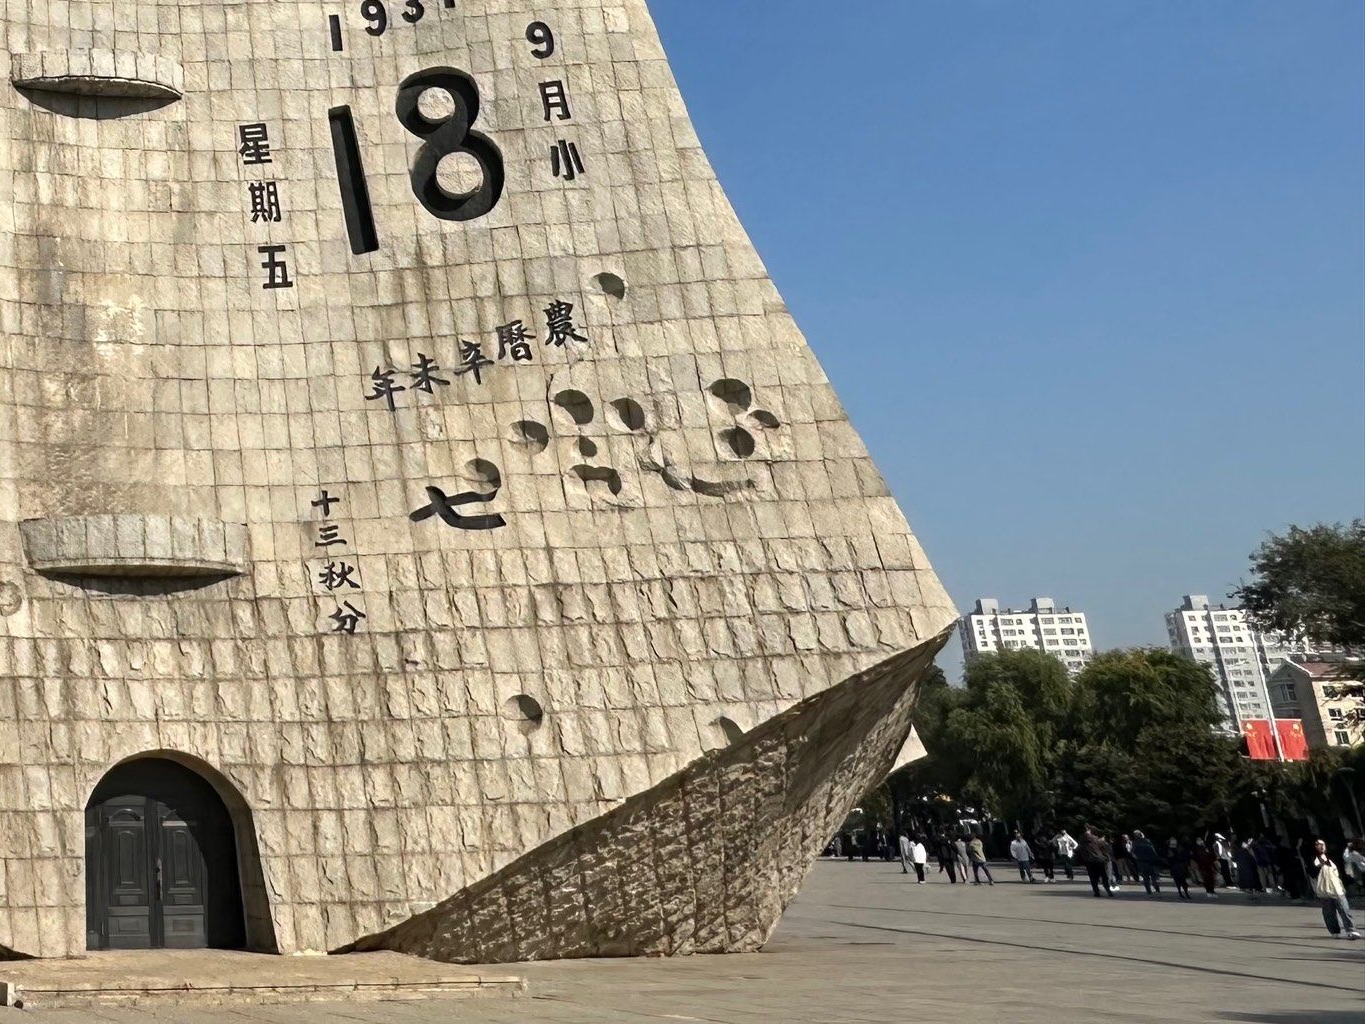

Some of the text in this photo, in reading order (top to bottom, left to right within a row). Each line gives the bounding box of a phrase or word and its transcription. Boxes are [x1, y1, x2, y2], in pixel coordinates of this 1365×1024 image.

[239, 123, 292, 290] 星期五
[328, 65, 505, 255] 18
